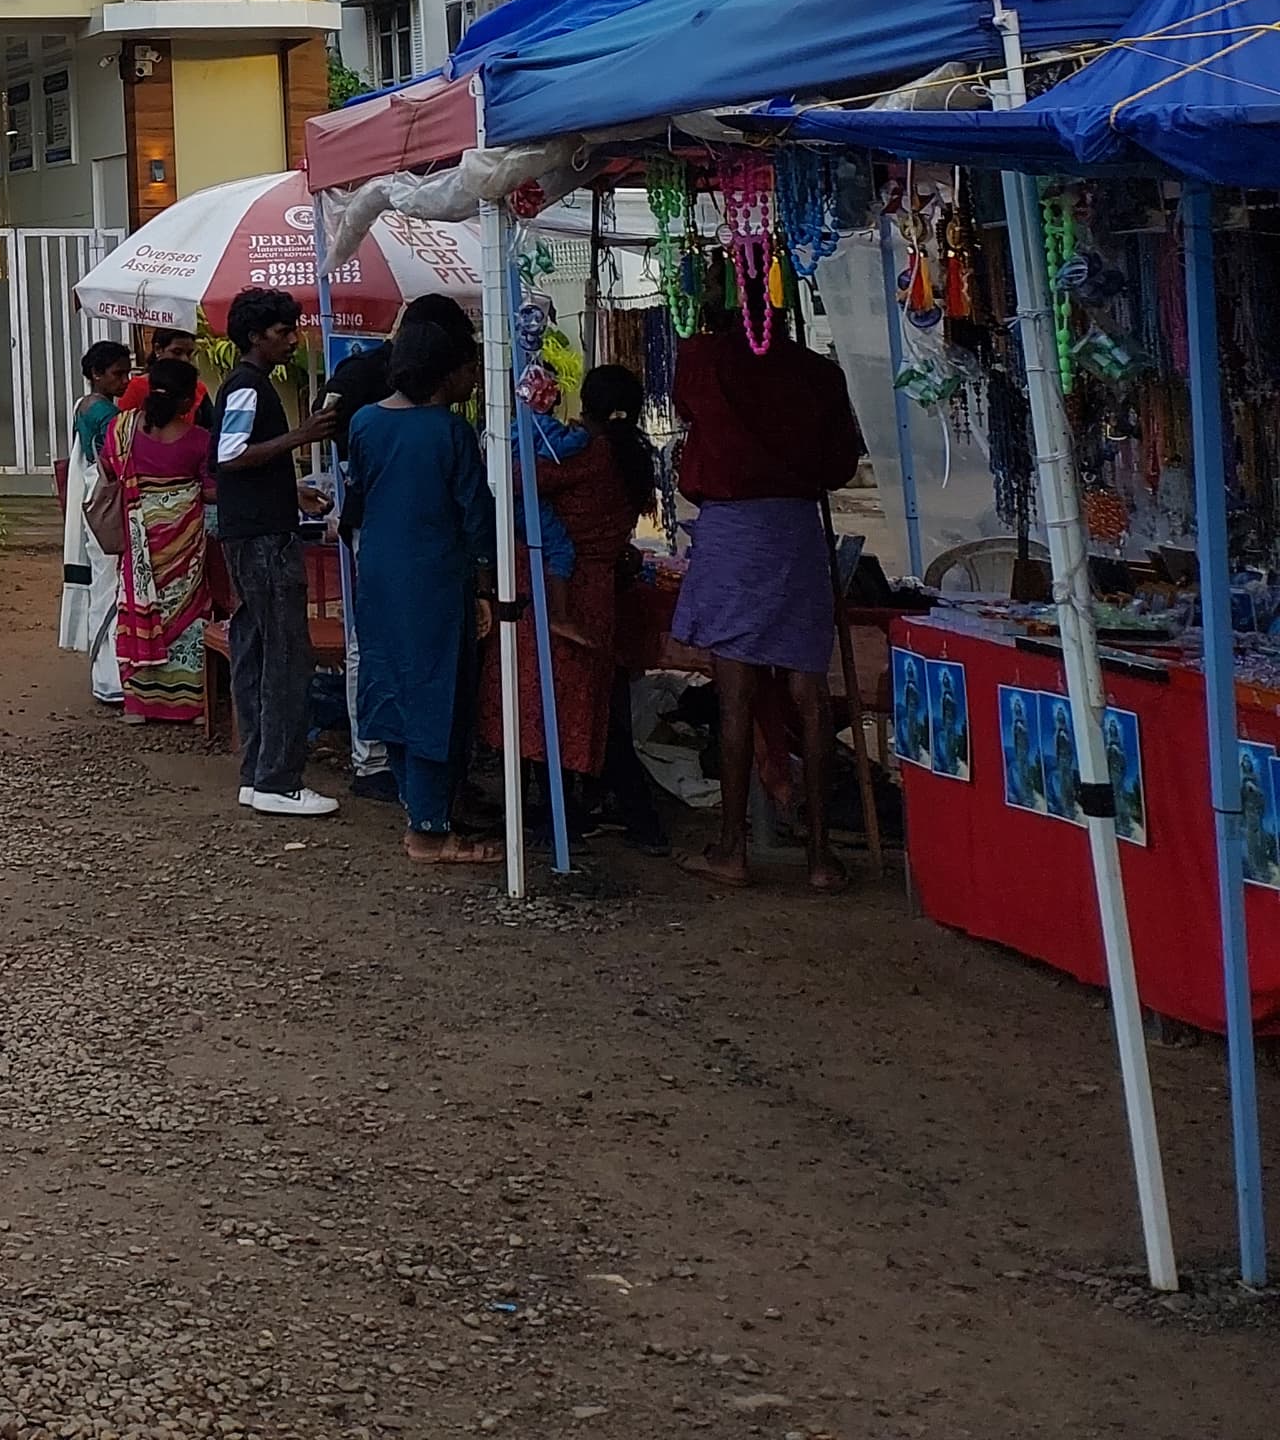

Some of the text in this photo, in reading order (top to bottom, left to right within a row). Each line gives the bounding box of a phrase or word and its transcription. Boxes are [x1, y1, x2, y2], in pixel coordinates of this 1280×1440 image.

[248, 234, 316, 249] JEREM
[389, 230, 458, 247] IELTS
[136, 244, 202, 263] Overseas
[416, 249, 466, 265] CBT
[432, 267, 483, 284] PTE
